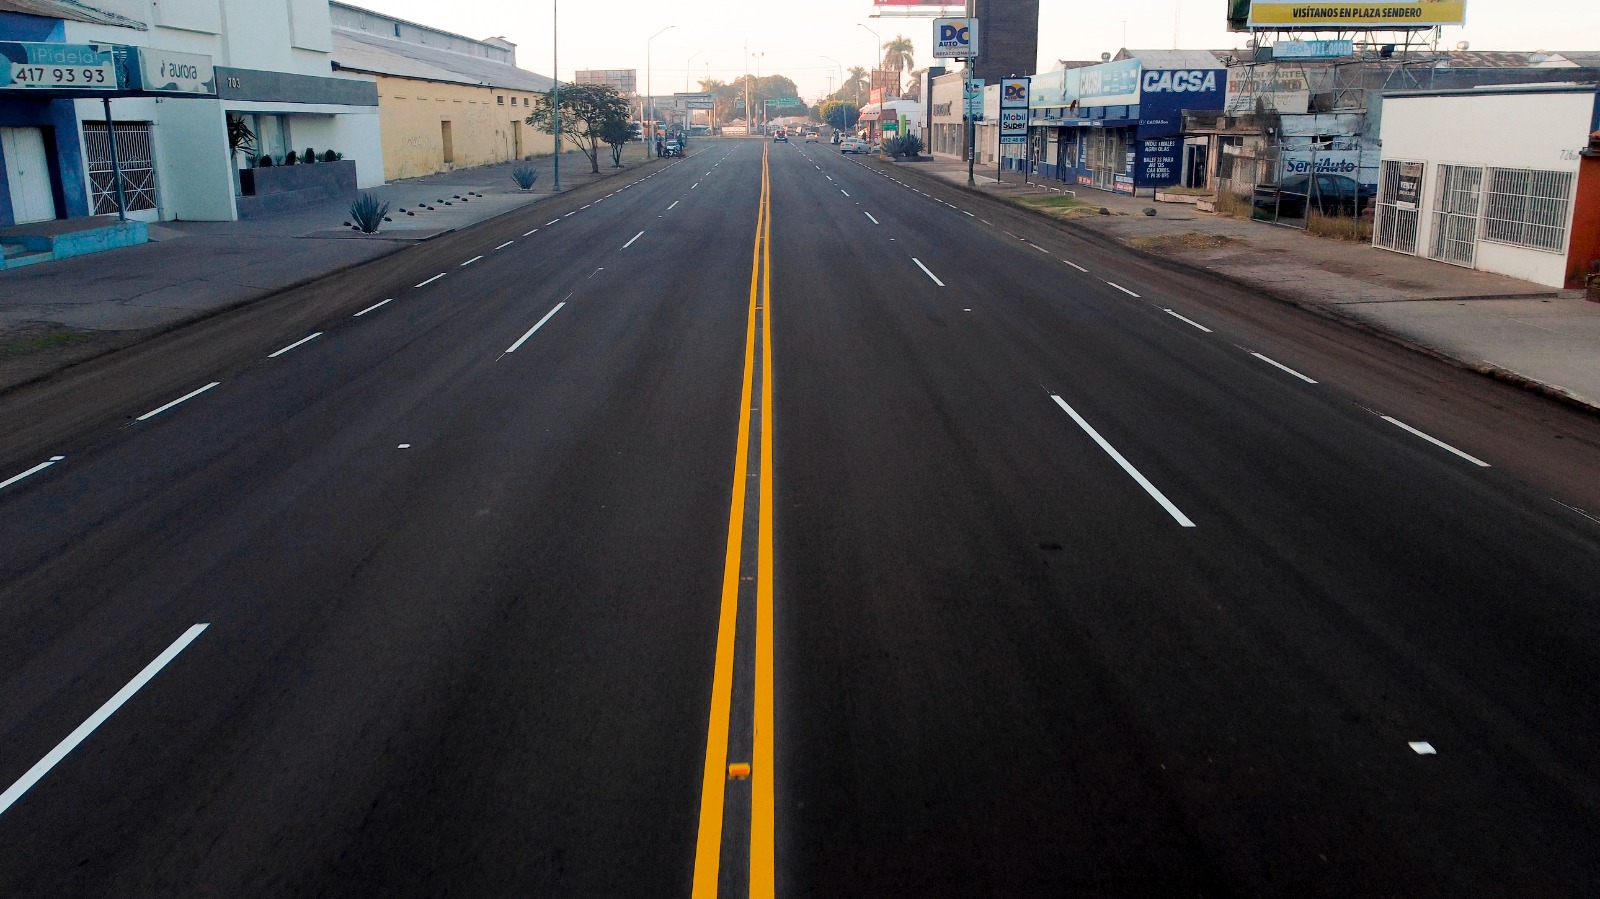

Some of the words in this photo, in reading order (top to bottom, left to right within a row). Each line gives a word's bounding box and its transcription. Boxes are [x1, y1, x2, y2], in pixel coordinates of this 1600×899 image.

[1293, 6, 1338, 17] VISÍTANOS
[1340, 8, 1351, 17] EN
[1353, 8, 1380, 17] PLAZA
[1382, 8, 1422, 17] SENDERO
[940, 25, 968, 44] DC
[16, 67, 44, 81] 417
[53, 68, 76, 82] 93
[83, 69, 105, 83] 93
[169, 62, 198, 80] aurora
[226, 77, 241, 88] 703
[1142, 71, 1216, 92] CACSA
[1005, 85, 1025, 99] DC
[1003, 113, 1026, 121] Mobil
